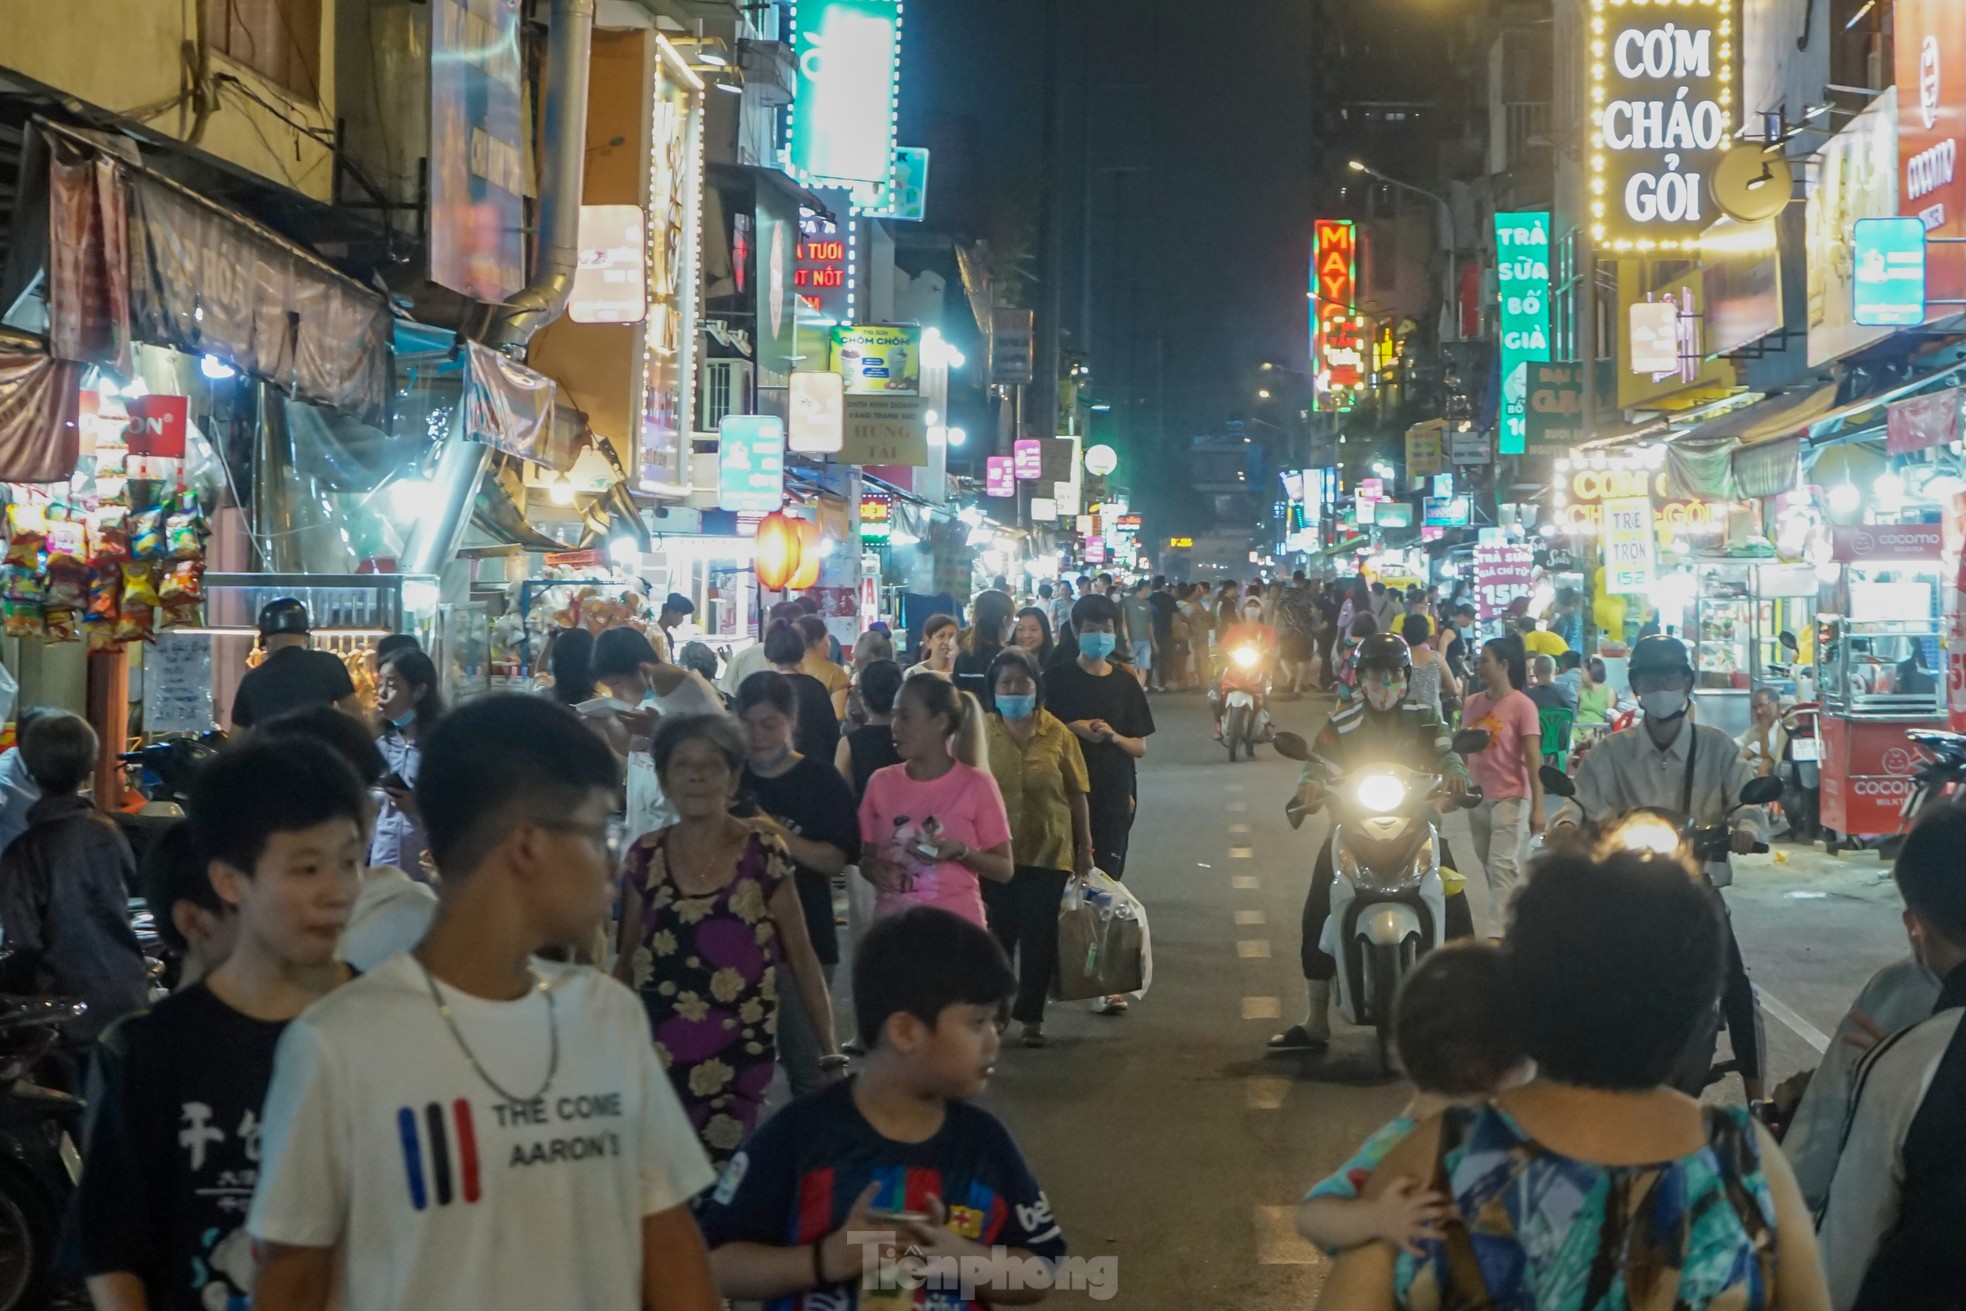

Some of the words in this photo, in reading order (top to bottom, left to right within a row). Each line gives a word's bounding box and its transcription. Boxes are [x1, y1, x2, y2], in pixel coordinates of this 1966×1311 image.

[1614, 22, 1711, 79] CƠM
[1602, 86, 1723, 150] CHÁO
[1625, 153, 1701, 222] GỎI
[1497, 220, 1547, 246] TRÀ
[808, 242, 843, 260] TƯƠI
[813, 265, 843, 287] NỐT
[1498, 256, 1549, 281] SỮA
[1507, 289, 1542, 315] BỐ
[1504, 324, 1547, 350] GIÀ
[853, 424, 910, 439] HƯNG
[1478, 550, 1502, 563] TRÀ
[492, 1098, 548, 1127] THE
